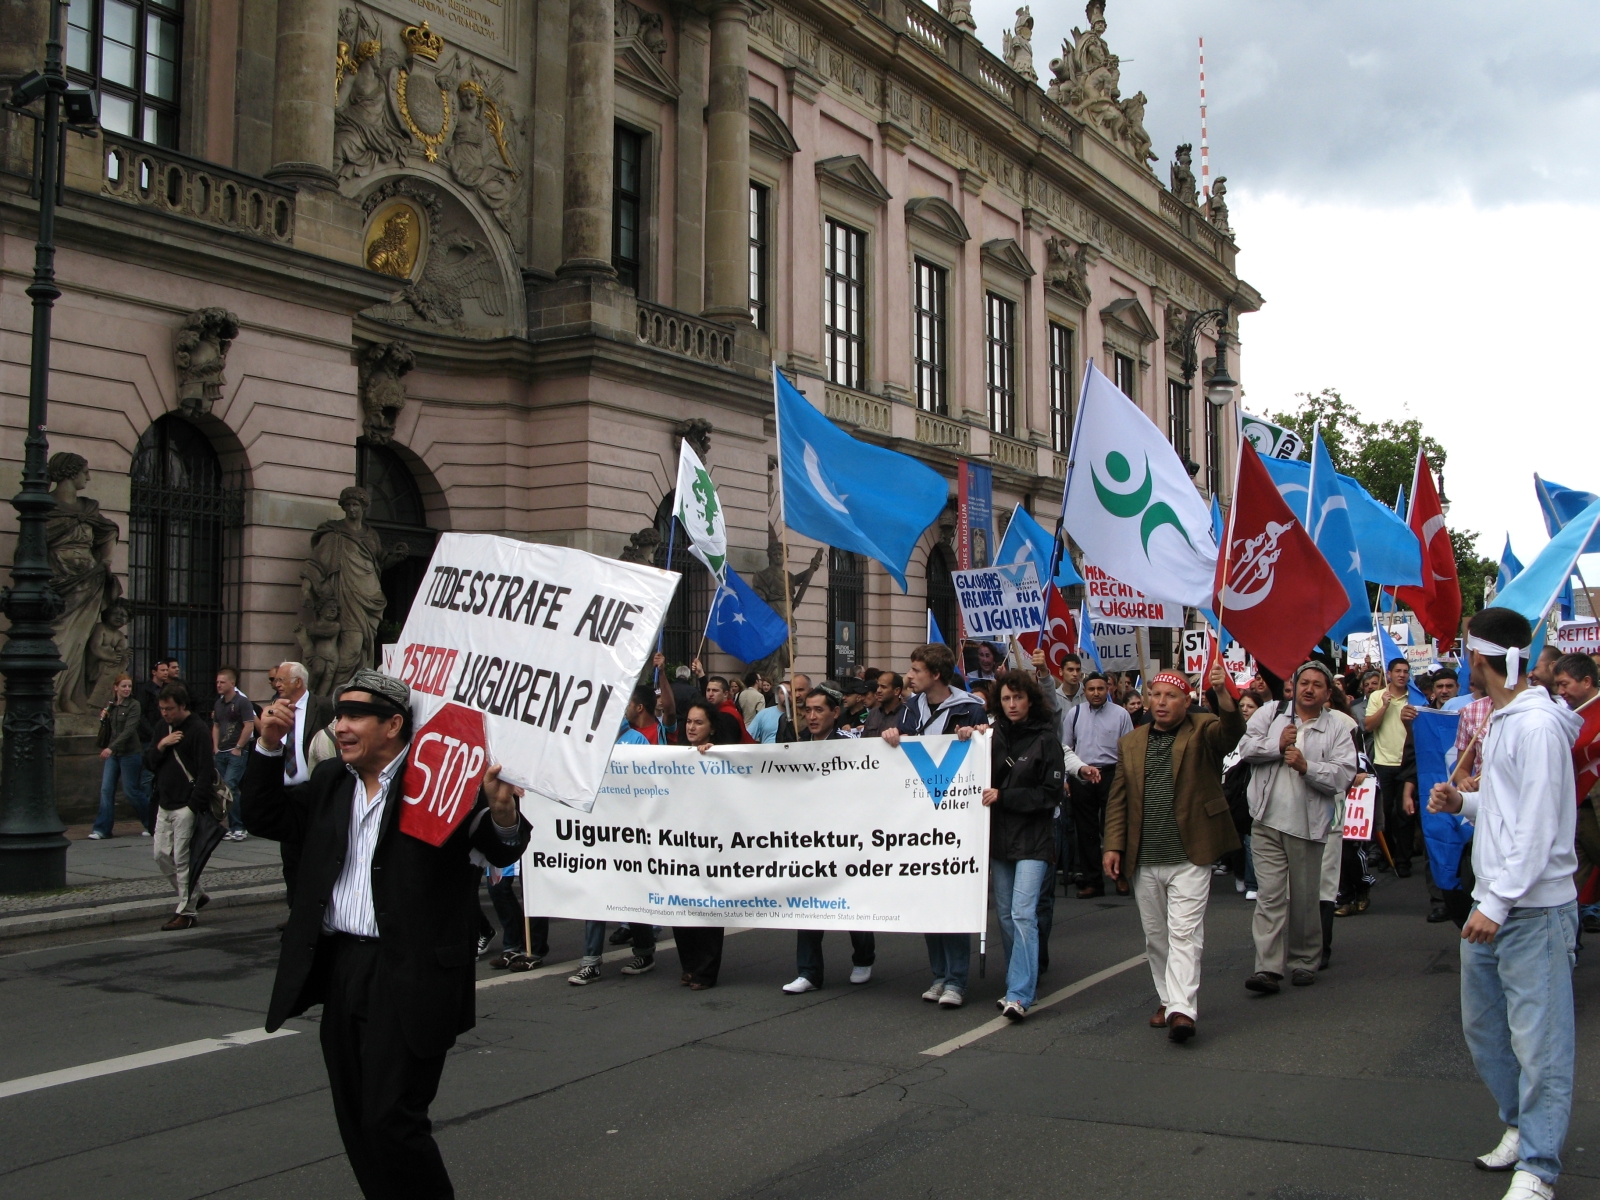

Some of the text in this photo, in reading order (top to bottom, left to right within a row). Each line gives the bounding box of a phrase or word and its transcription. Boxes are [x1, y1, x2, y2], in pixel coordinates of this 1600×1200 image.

[956, 572, 1001, 590] GLAUBENS
[424, 565, 644, 646] TODESSTRAFE AUF
[960, 589, 1041, 609] FREIHEIT FÜR
[968, 606, 1043, 633] UIGUREN
[399, 643, 459, 697] 15000
[610, 760, 629, 775] für
[632, 760, 695, 775] bedrohte
[698, 759, 753, 775] Völker
[403, 731, 485, 824] STOP
[904, 771, 975, 789] gesellschaft
[633, 785, 670, 799] peoples
[912, 785, 982, 799] für bedrohte
[934, 799, 970, 811] völker
[1347, 803, 1364, 819] in
[555, 818, 962, 853] Uiguren: Kultur, Architektur, Sprache,
[533, 852, 980, 878] Religion von China unterdrückt oder zerstört.
[648, 892, 851, 910] Für Menschenrechte. Weltweit.
[837, 913, 855, 921] Status
[856, 913, 871, 921] beim
[872, 913, 901, 923] Europarat
